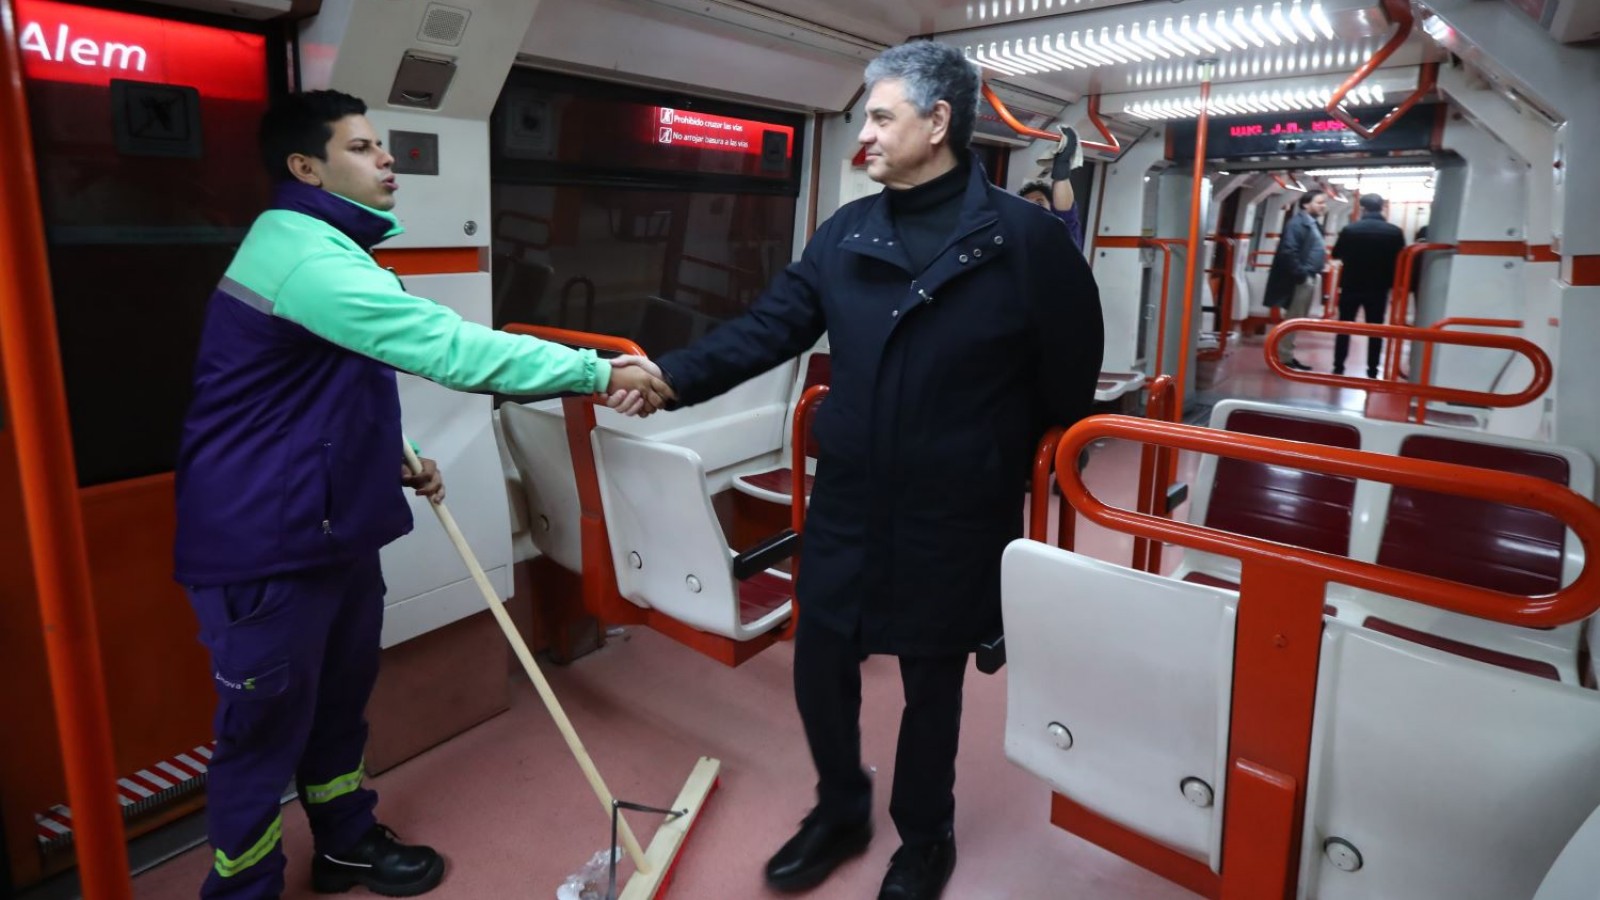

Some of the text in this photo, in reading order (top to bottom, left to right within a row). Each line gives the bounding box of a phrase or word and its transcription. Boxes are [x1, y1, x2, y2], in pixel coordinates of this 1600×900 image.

[20, 21, 147, 71] Alem
[673, 114, 704, 127] Prohibido
[704, 120, 723, 129] cruzar
[723, 122, 732, 130] las
[672, 131, 683, 140] No
[683, 134, 705, 144] arrojar
[705, 136, 724, 145] basura
[729, 138, 738, 147] las
